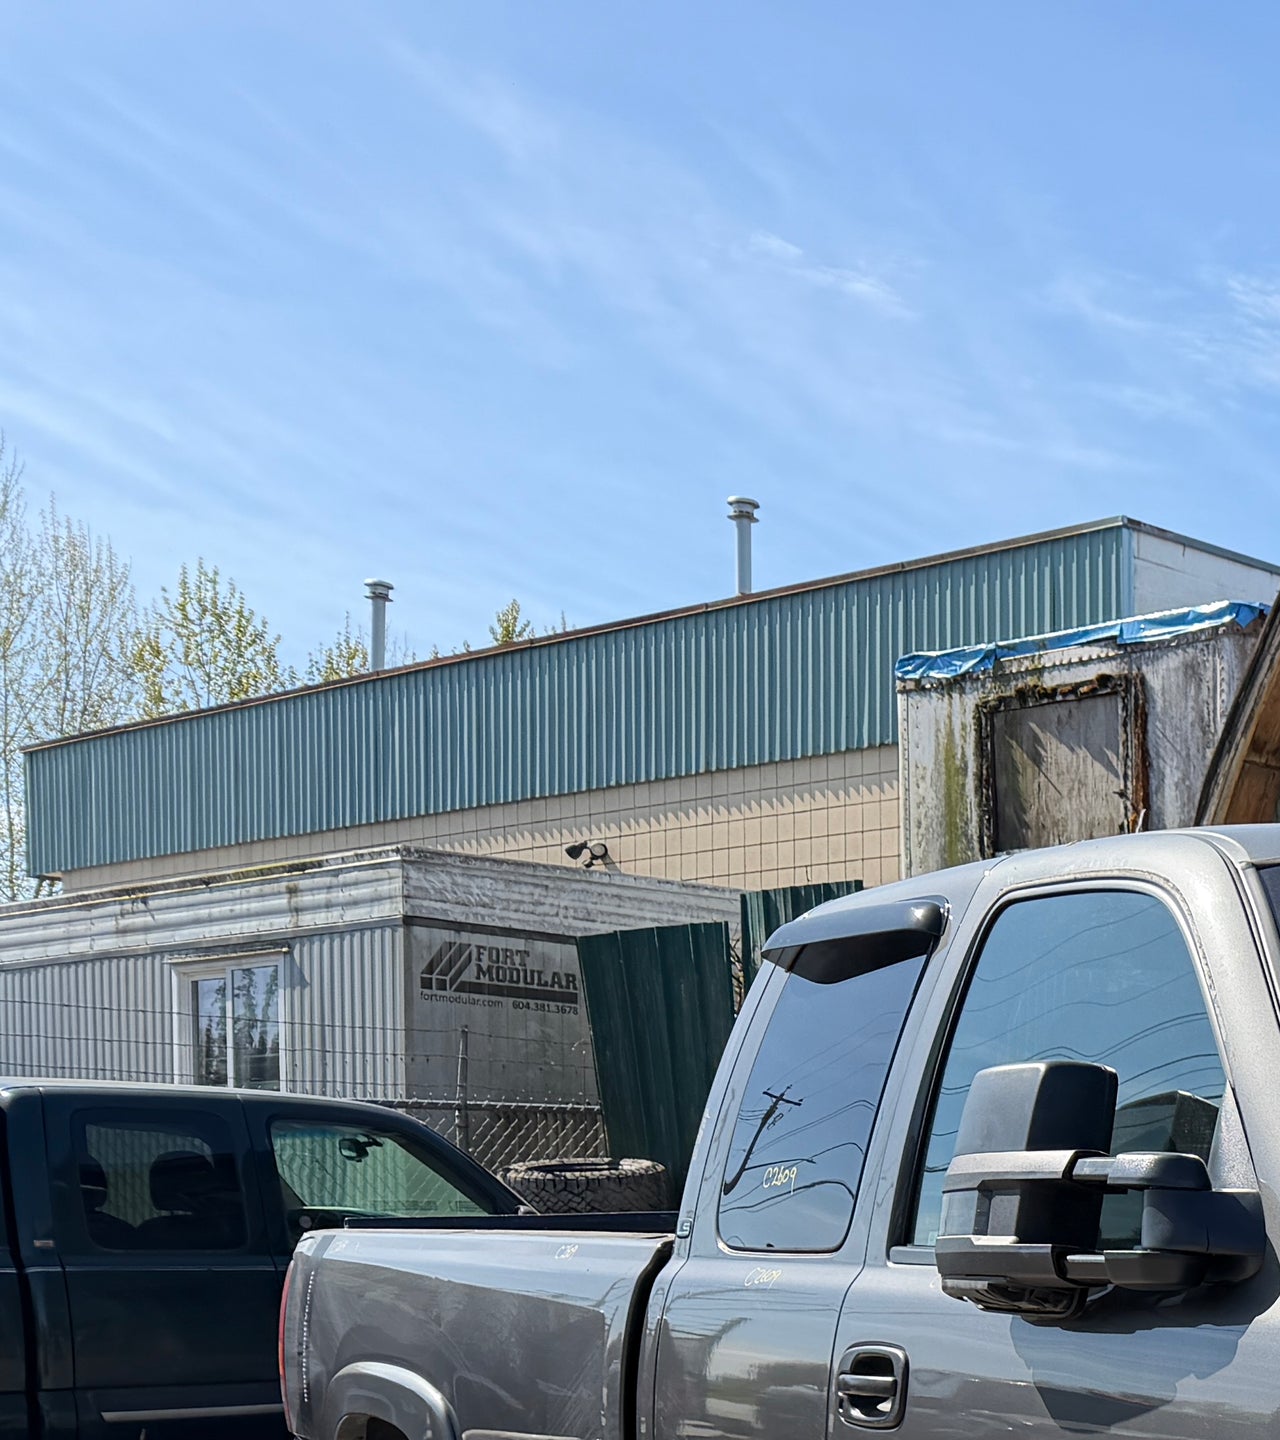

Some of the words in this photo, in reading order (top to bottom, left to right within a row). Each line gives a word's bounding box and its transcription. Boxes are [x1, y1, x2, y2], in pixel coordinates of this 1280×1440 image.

[474, 944, 530, 967] FORT
[475, 963, 578, 991] MODULAR
[420, 990, 503, 1009] fortmodular.com
[512, 1001, 578, 1015] 604.381.3678
